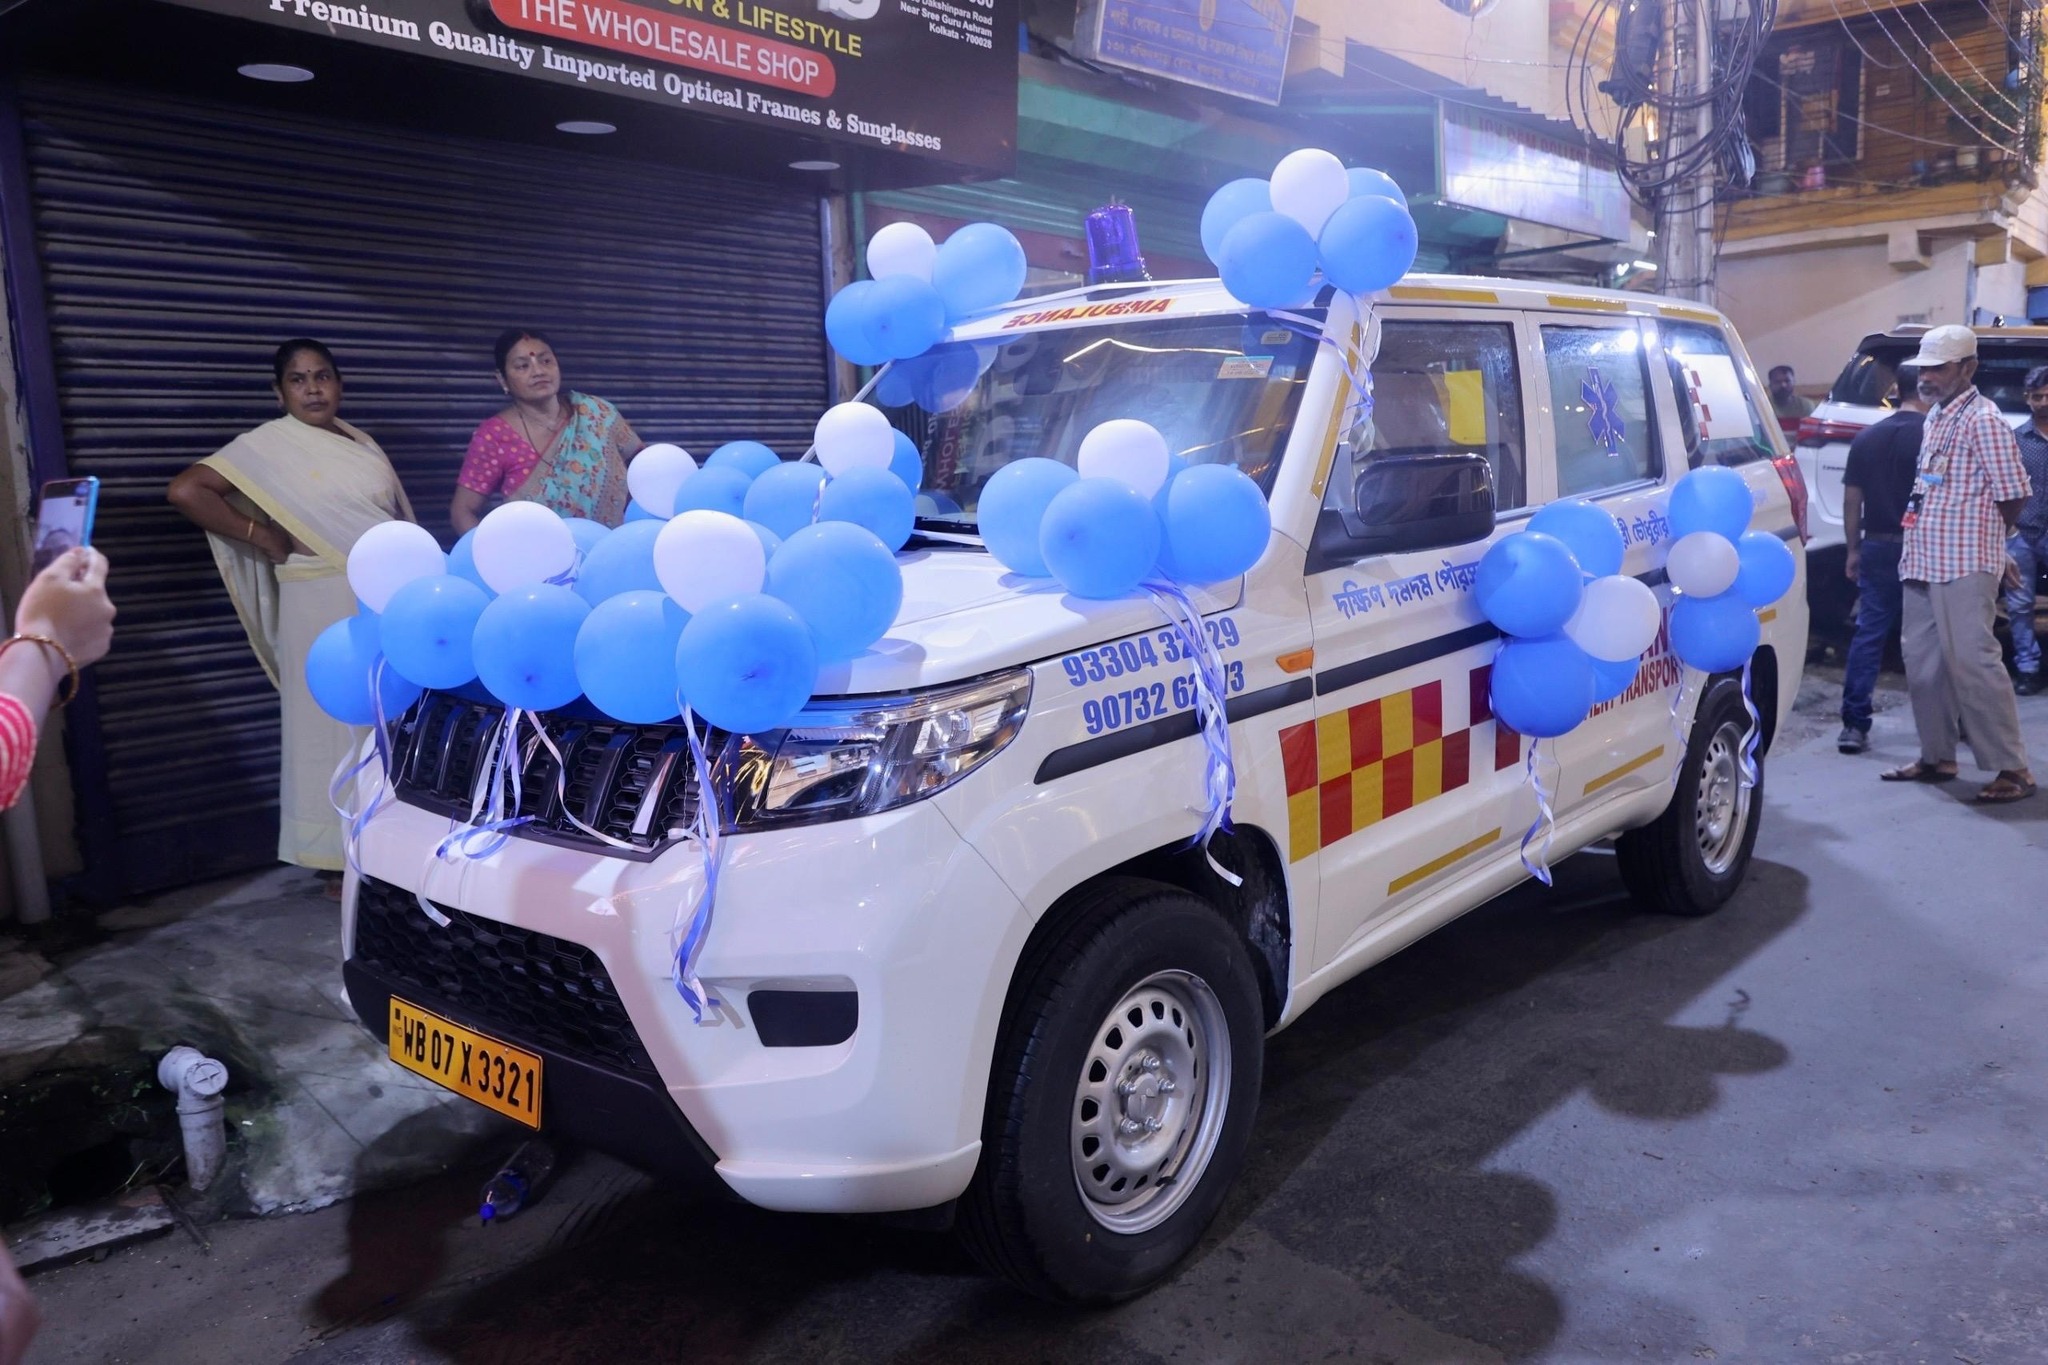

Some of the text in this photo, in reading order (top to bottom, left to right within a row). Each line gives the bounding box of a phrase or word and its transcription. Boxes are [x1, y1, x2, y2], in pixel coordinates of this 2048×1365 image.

[583, 4, 751, 70] WHOLESALE
[757, 48, 819, 85] SHOP
[738, 2, 862, 57] LIFESTYLE
[900, 1, 992, 36] Near Sree Guru Ashram
[929, 22, 959, 39] Kolkata
[966, 33, 992, 48] 700028
[971, 11, 992, 25] Road
[428, 20, 536, 70] Quality
[542, 45, 657, 91] Imported
[663, 73, 743, 110] Optical
[746, 92, 821, 126] Frames
[826, 109, 842, 130] &
[847, 113, 942, 150] Sunglasses
[1333, 580, 1386, 619] দক্ষিণ
[1384, 573, 1433, 606] দমদম
[1062, 617, 1240, 687] 93304 3229
[1083, 682, 1167, 735] 90732
[404, 1015, 426, 1062] WB
[431, 1030, 455, 1075] 07
[461, 1041, 472, 1086] X
[478, 1050, 534, 1113] 3321
